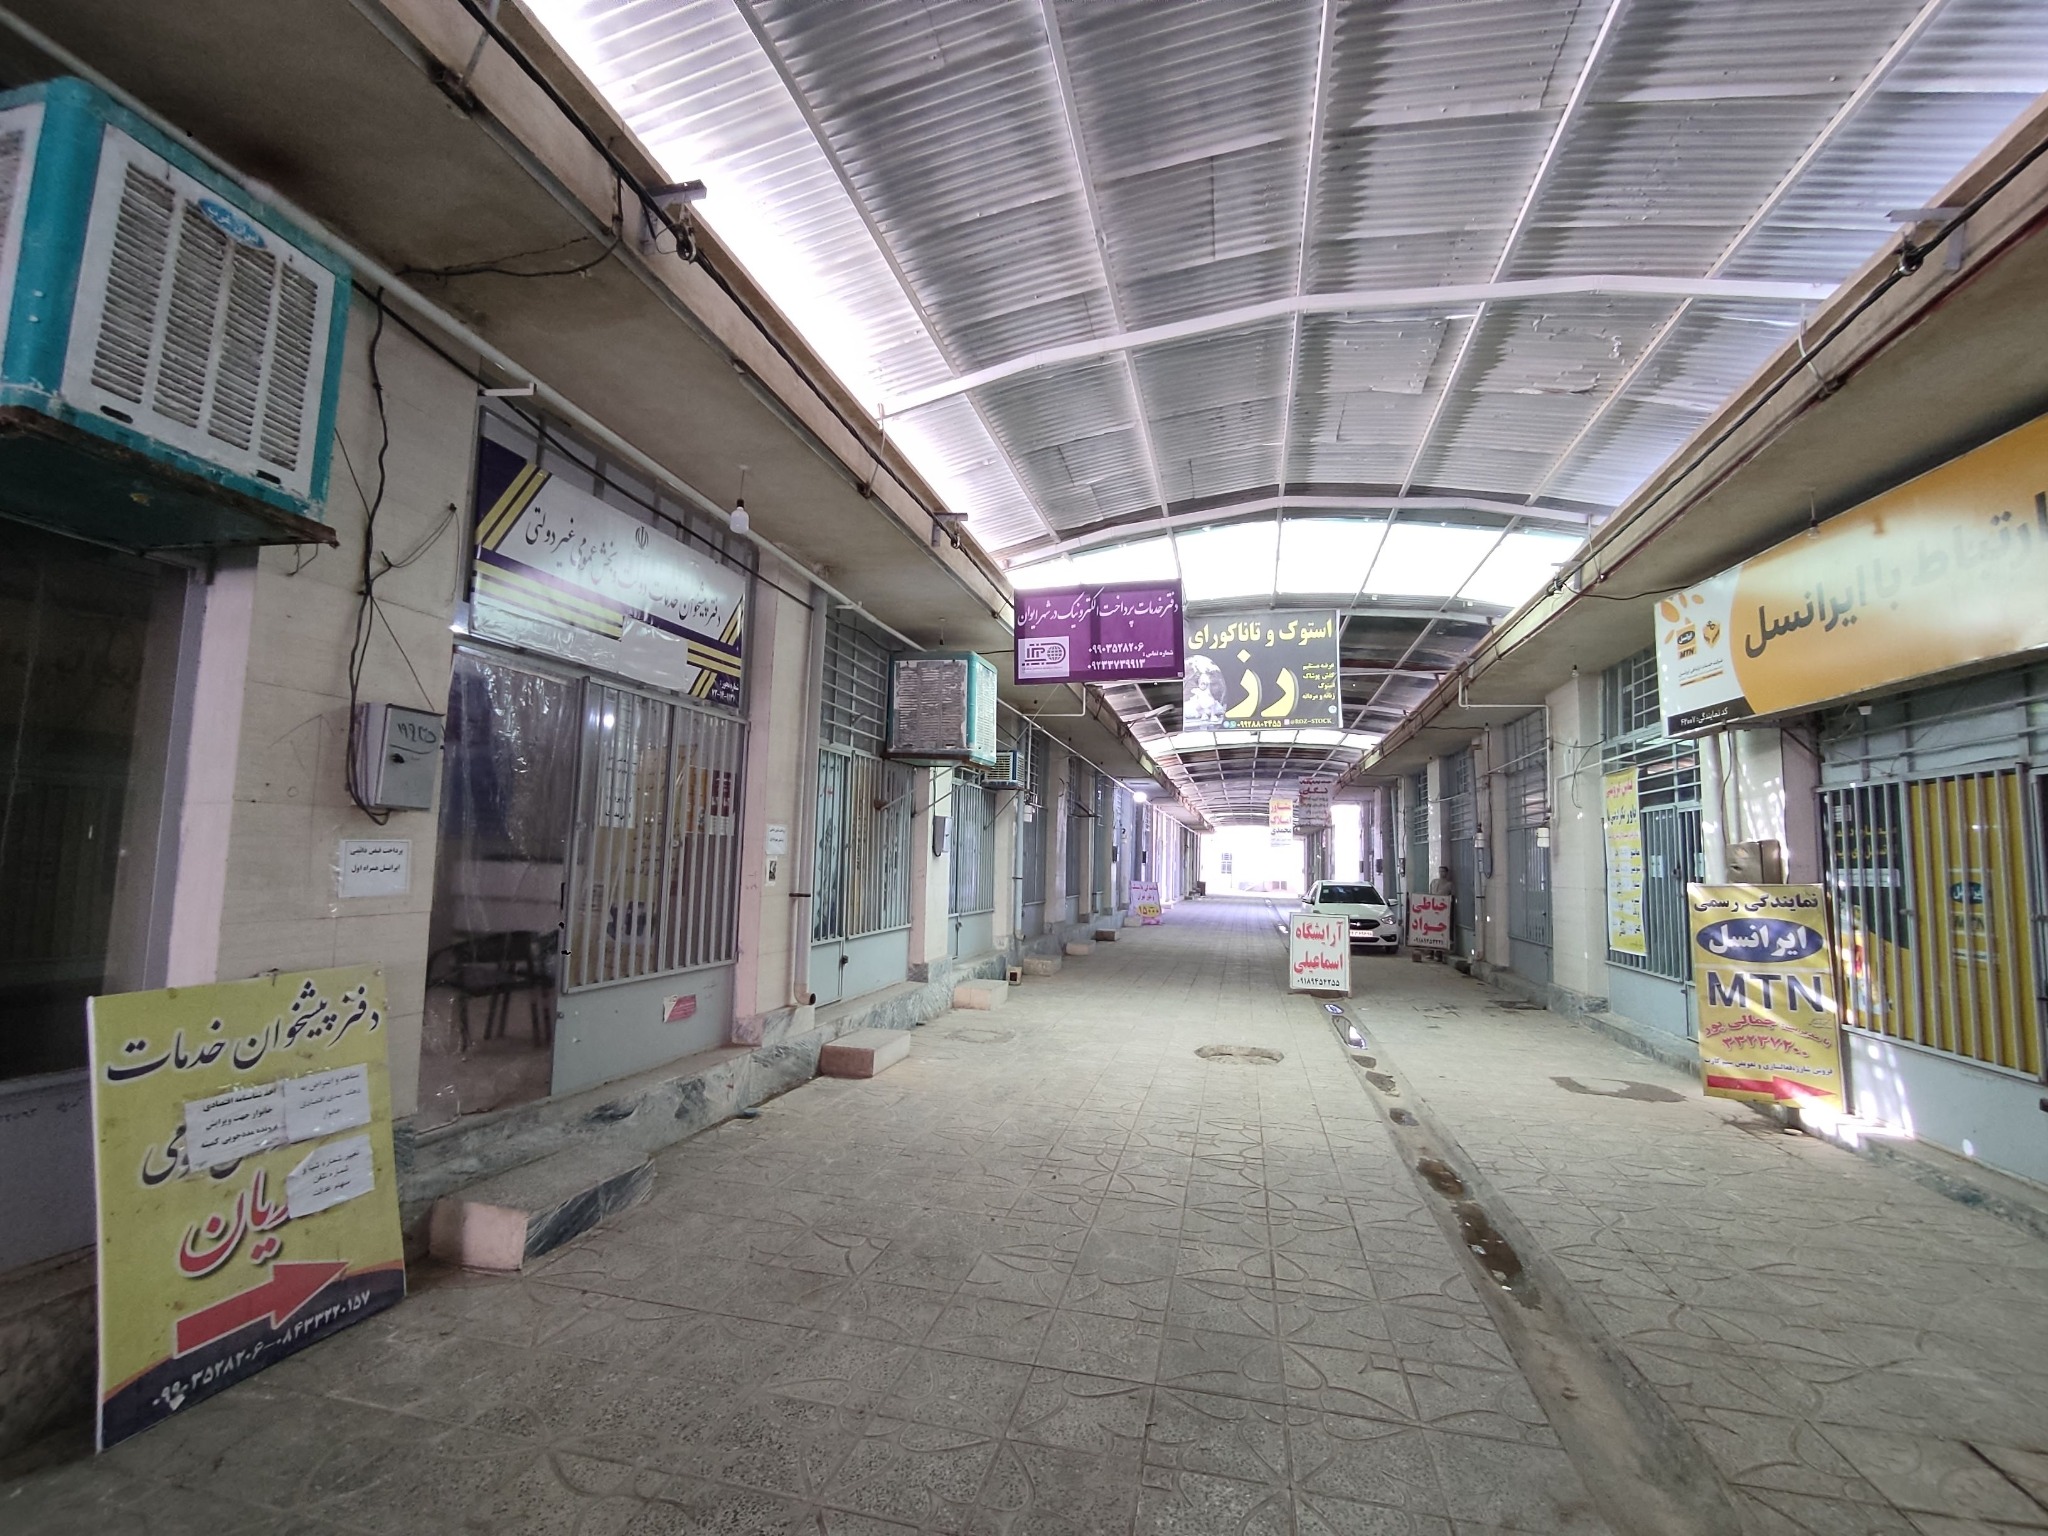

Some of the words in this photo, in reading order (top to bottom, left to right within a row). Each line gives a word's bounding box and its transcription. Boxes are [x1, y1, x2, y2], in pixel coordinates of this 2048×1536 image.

[525, 507, 556, 546] دولتی
[570, 538, 596, 571] عمومی
[1058, 587, 1104, 629] الکترونیک
[1099, 595, 1135, 628] پرداخت
[1134, 596, 1164, 615] خدمات
[1160, 591, 1179, 618] دفتر
[1745, 565, 1867, 659] ایرانسل
[1187, 621, 1261, 650] تاناکورای
[1264, 629, 1275, 647] و
[1279, 618, 1332, 646] استوک
[1224, 649, 1297, 718] رز
[1412, 896, 1448, 915] خیاطی
[1694, 898, 1740, 912] رسمی
[1296, 921, 1343, 948] آرایشگاه
[1411, 916, 1447, 937] جواد
[1709, 924, 1807, 957] ایرانسل
[1293, 950, 1343, 974] اسماعیلی
[1707, 971, 1824, 1012] MTN
[233, 980, 337, 1070] پیشخوان
[330, 985, 381, 1048] دفتر
[1705, 1021, 1727, 1038] پور
[1728, 1015, 1777, 1030] جمالی
[106, 1019, 227, 1081] خدمات
[252, 1107, 273, 1120] خانوار
